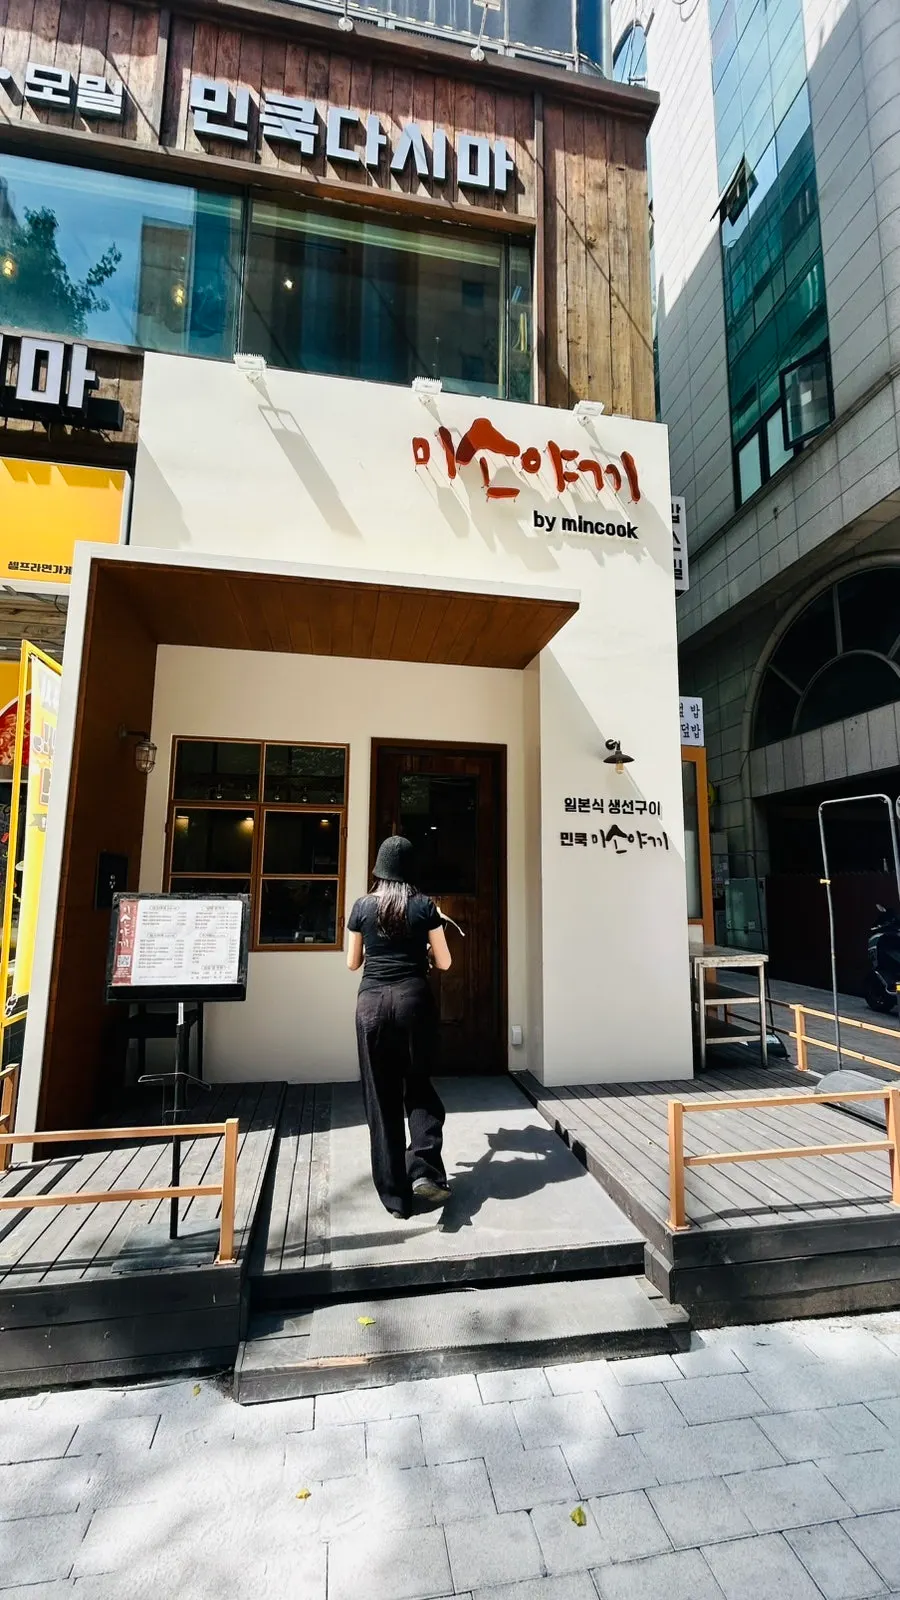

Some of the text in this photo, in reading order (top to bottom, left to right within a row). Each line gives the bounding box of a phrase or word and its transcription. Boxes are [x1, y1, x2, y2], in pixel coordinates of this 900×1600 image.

[189, 77, 514, 192] 민쿡다시마
[533, 510, 639, 540] by mincook
[564, 797, 661, 816] 일본식 생선구이
[560, 831, 588, 847] 민쿡
